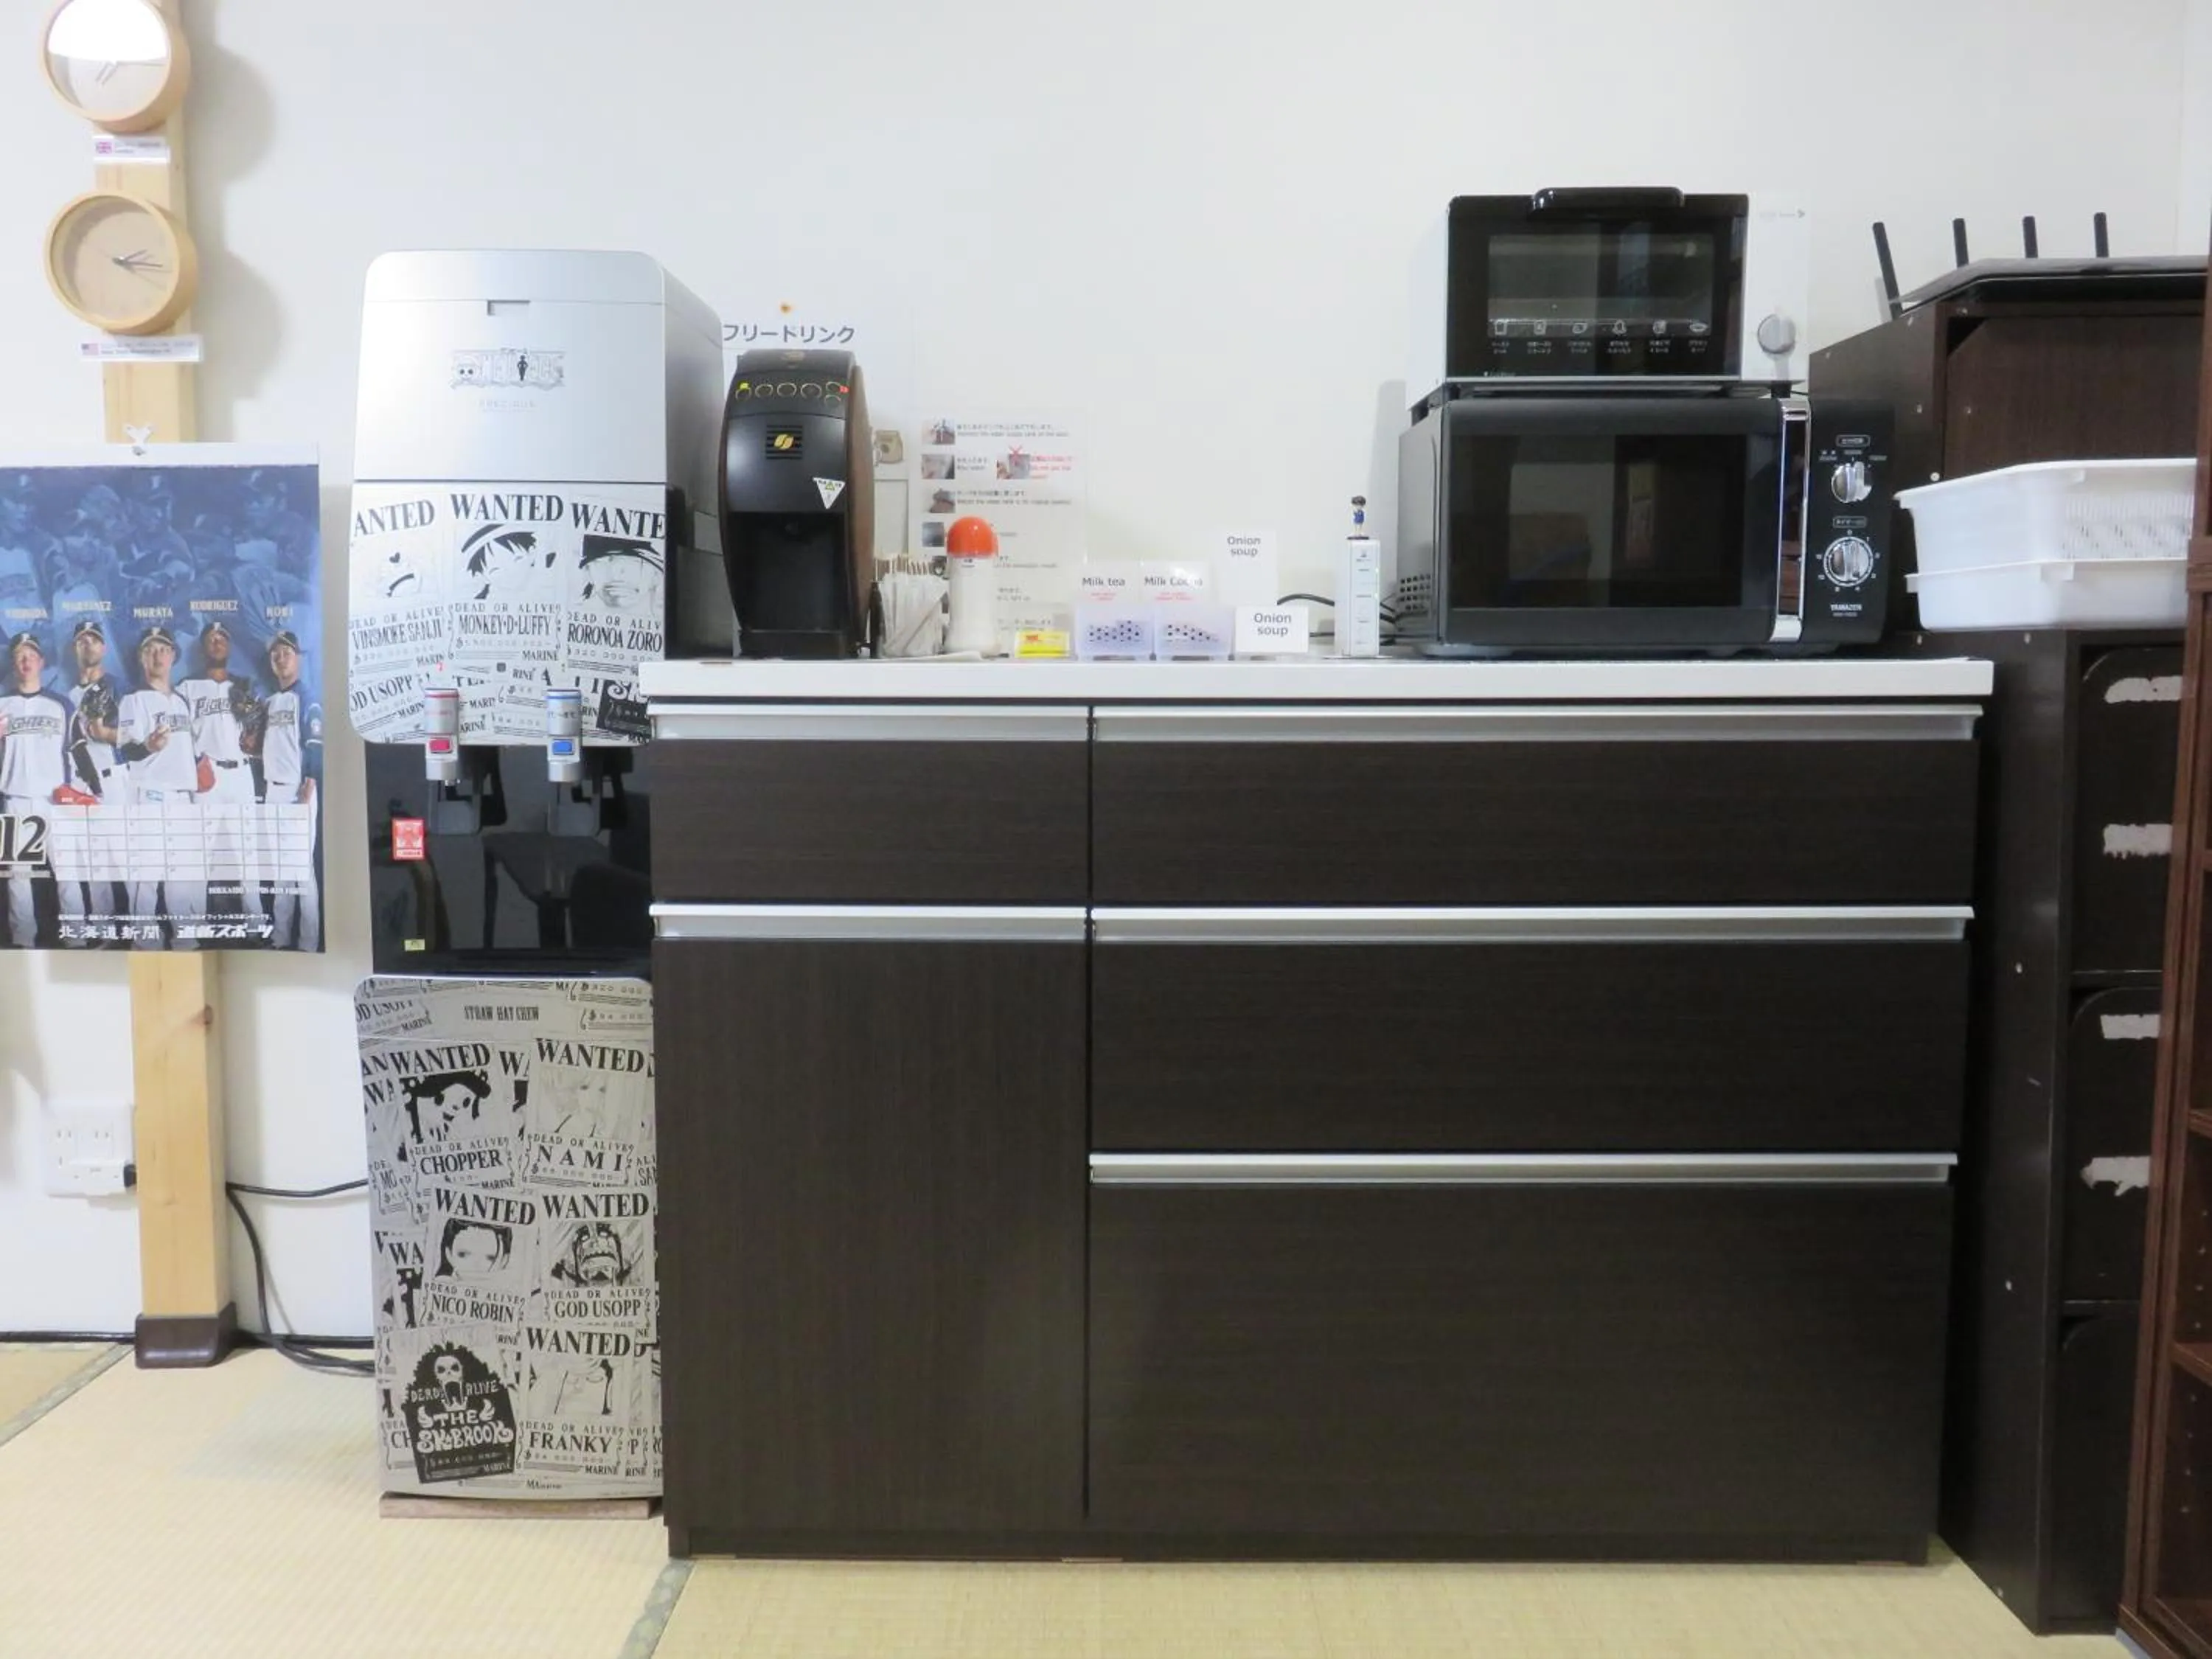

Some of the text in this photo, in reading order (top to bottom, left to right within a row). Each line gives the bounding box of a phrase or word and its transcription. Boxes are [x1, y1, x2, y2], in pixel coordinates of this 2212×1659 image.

[723, 324, 855, 343] フリードリンク
[451, 494, 565, 521] WANTED
[1227, 536, 1261, 545] Onion
[1231, 547, 1258, 557] soup
[1082, 577, 1125, 586] Milk tea
[1144, 576, 1166, 586] Milk
[455, 602, 486, 613] DEAD
[1253, 613, 1292, 623] Onion
[567, 622, 624, 649] RORONOA
[627, 629, 663, 653] ZORO
[1257, 626, 1289, 637] soup
[368, 674, 413, 703] USOPP
[59, 925, 160, 941] 北海道新聞
[389, 1043, 491, 1075] WANTED
[535, 1037, 645, 1073] WANTED
[533, 1133, 563, 1145] DEAD
[414, 1144, 442, 1155] DEAD
[538, 1144, 623, 1172] NAMI
[420, 1149, 504, 1175] CHOPPER
[434, 1187, 536, 1225] WANTED
[542, 1192, 650, 1219] WANTED
[430, 1282, 458, 1294] DEAD
[431, 1293, 515, 1323] NICO ROBIN
[554, 1299, 642, 1318] GOD USOPP
[526, 1326, 631, 1357] WANTED
[433, 1409, 479, 1427] THE
[525, 1420, 554, 1431] DEAD
[529, 1430, 613, 1454] FRANKY
